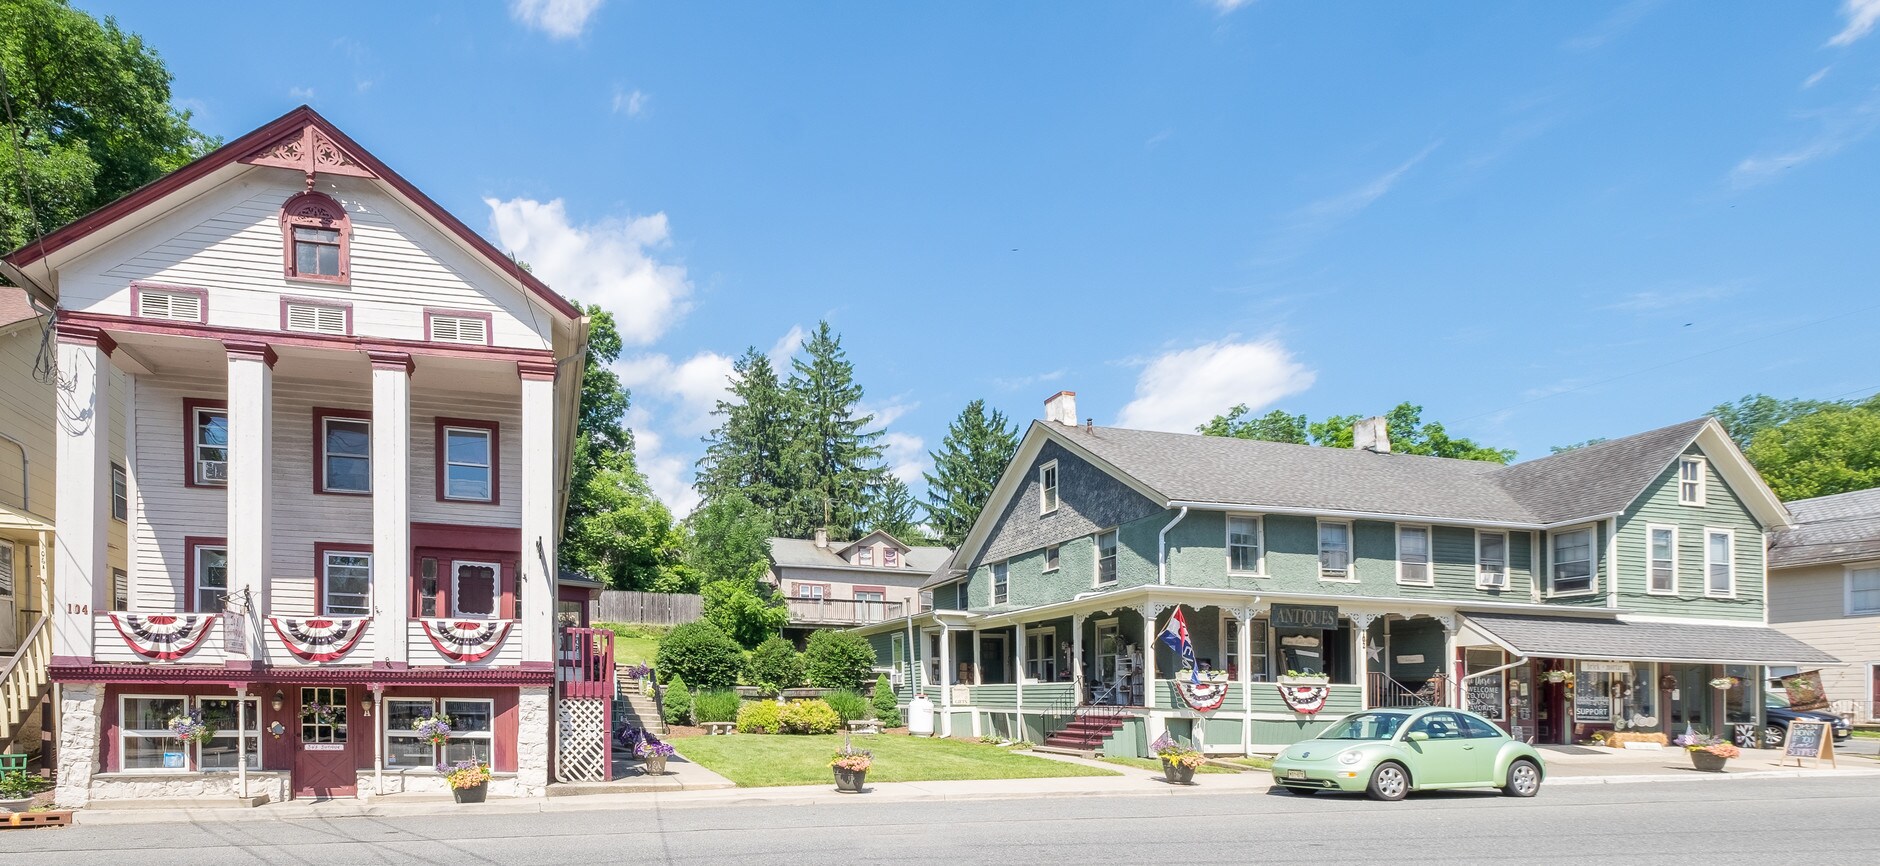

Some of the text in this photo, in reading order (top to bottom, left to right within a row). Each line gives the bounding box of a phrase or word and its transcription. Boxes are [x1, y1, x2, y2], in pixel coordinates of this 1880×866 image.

[68, 603, 88, 615] 104
[1277, 608, 1334, 627] ANTIQUES
[1468, 686, 1499, 694] WELCOME
[1477, 692, 1496, 700] YOUR
[1576, 708, 1608, 716] SUPPORT
